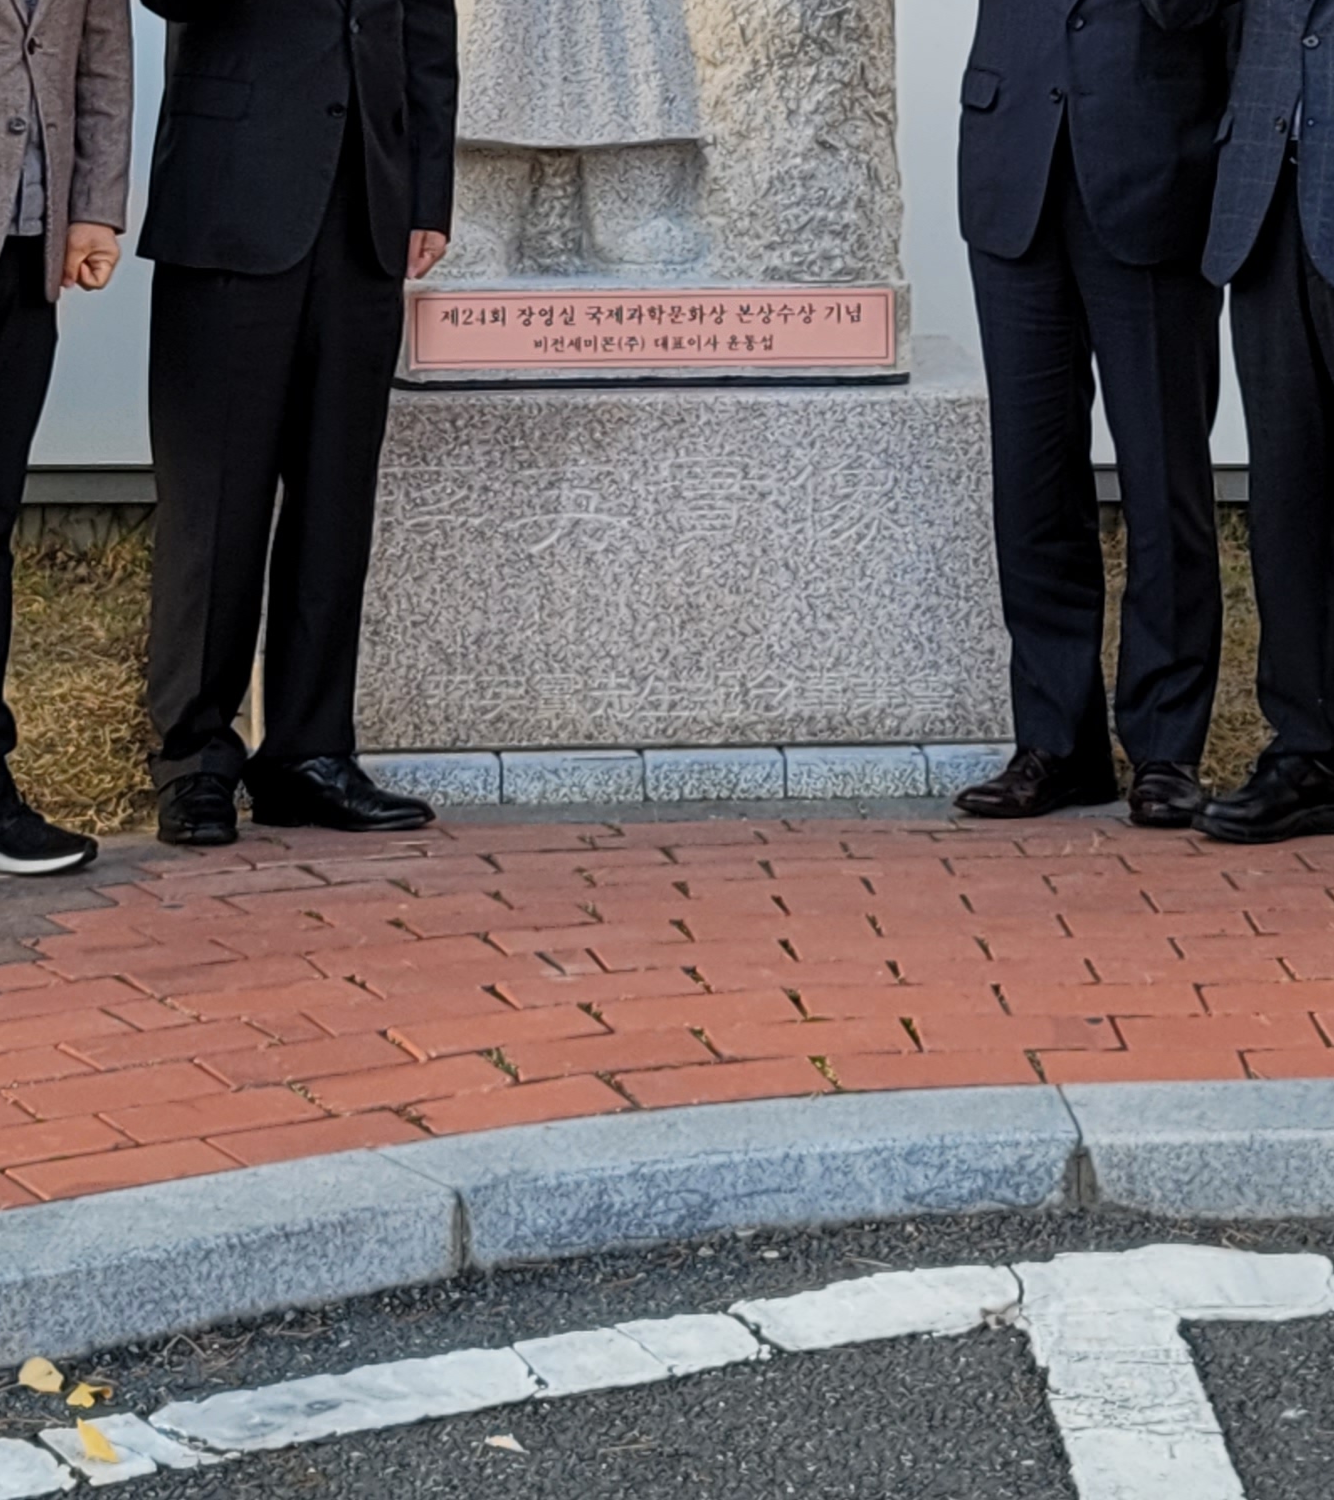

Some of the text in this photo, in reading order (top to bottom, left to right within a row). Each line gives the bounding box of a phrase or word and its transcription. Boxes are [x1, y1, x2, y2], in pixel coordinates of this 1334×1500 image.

[439, 302, 862, 327] 제24회 장영실 국제과학문화상 본상수상 기념
[653, 334, 719, 352] 대표이사
